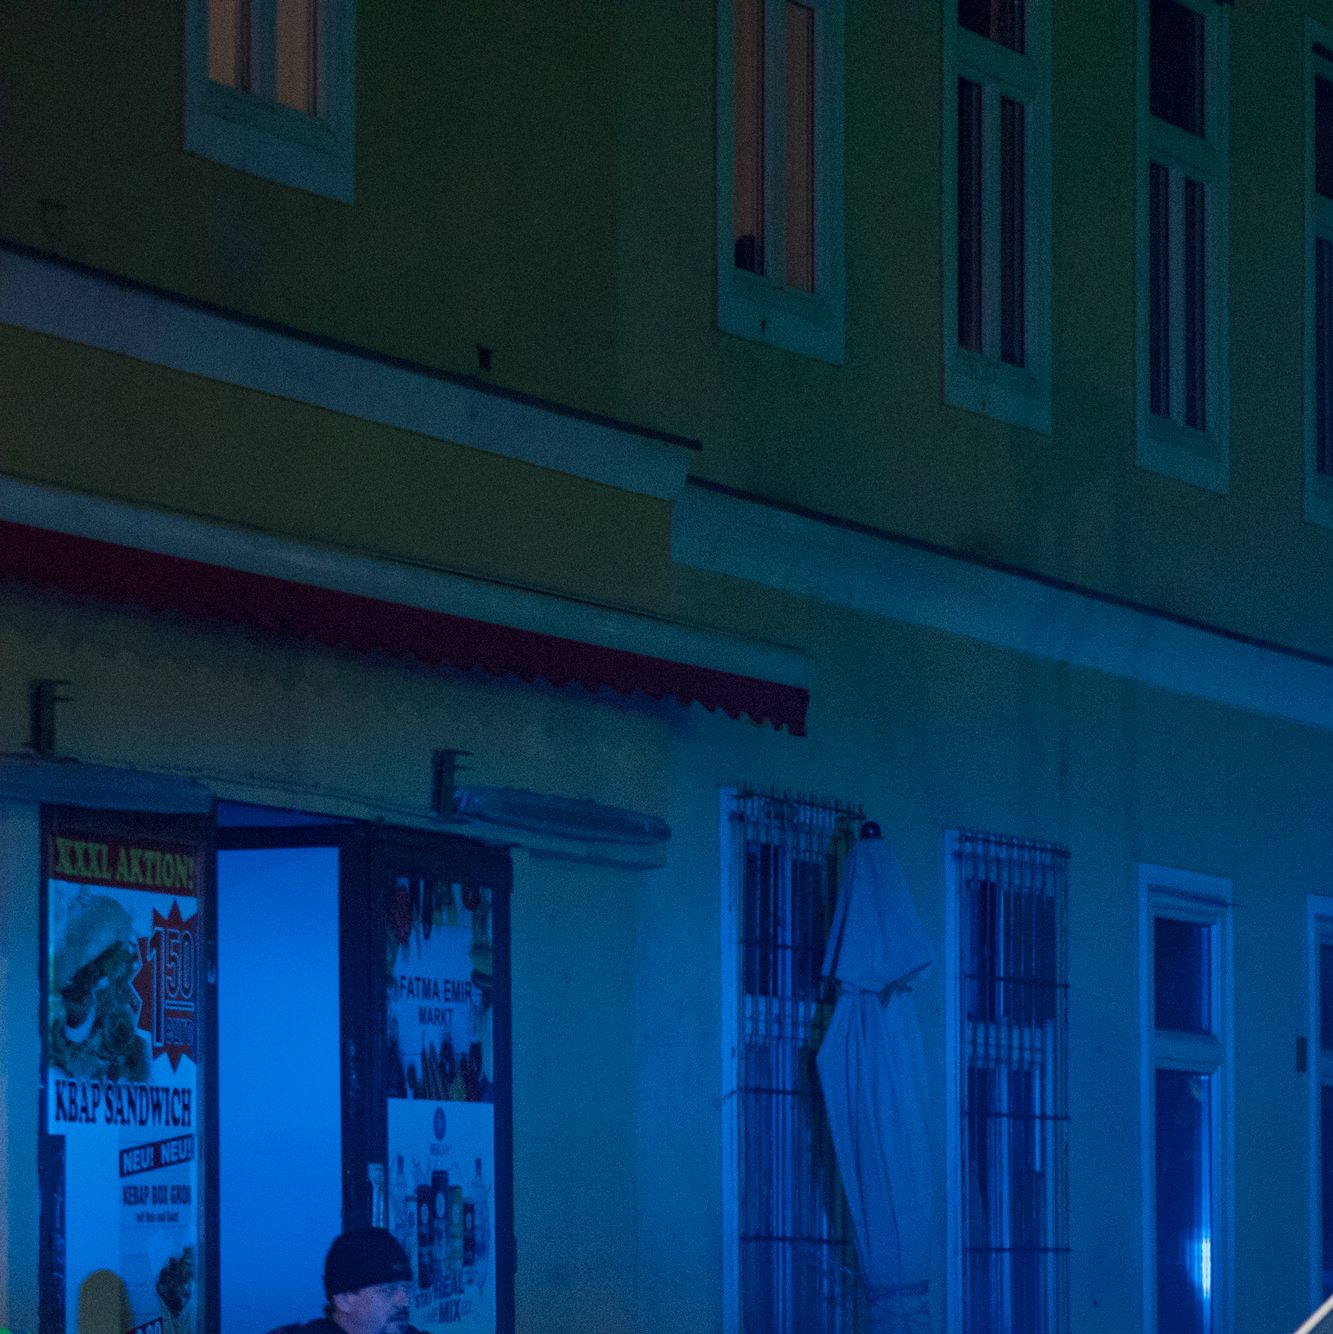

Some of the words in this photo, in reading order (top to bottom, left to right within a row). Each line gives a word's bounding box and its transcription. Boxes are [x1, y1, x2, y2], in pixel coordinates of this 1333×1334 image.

[55, 837, 112, 880] XXXL
[116, 846, 194, 889] AKTION!
[400, 975, 439, 1000] FATMA
[444, 978, 473, 1003] EMIR
[419, 1006, 454, 1026] MARKT
[55, 1079, 101, 1124] KBAP
[104, 1083, 192, 1127] SANDWICH
[122, 1145, 155, 1174] NEU!
[160, 1137, 194, 1164] NEU!
